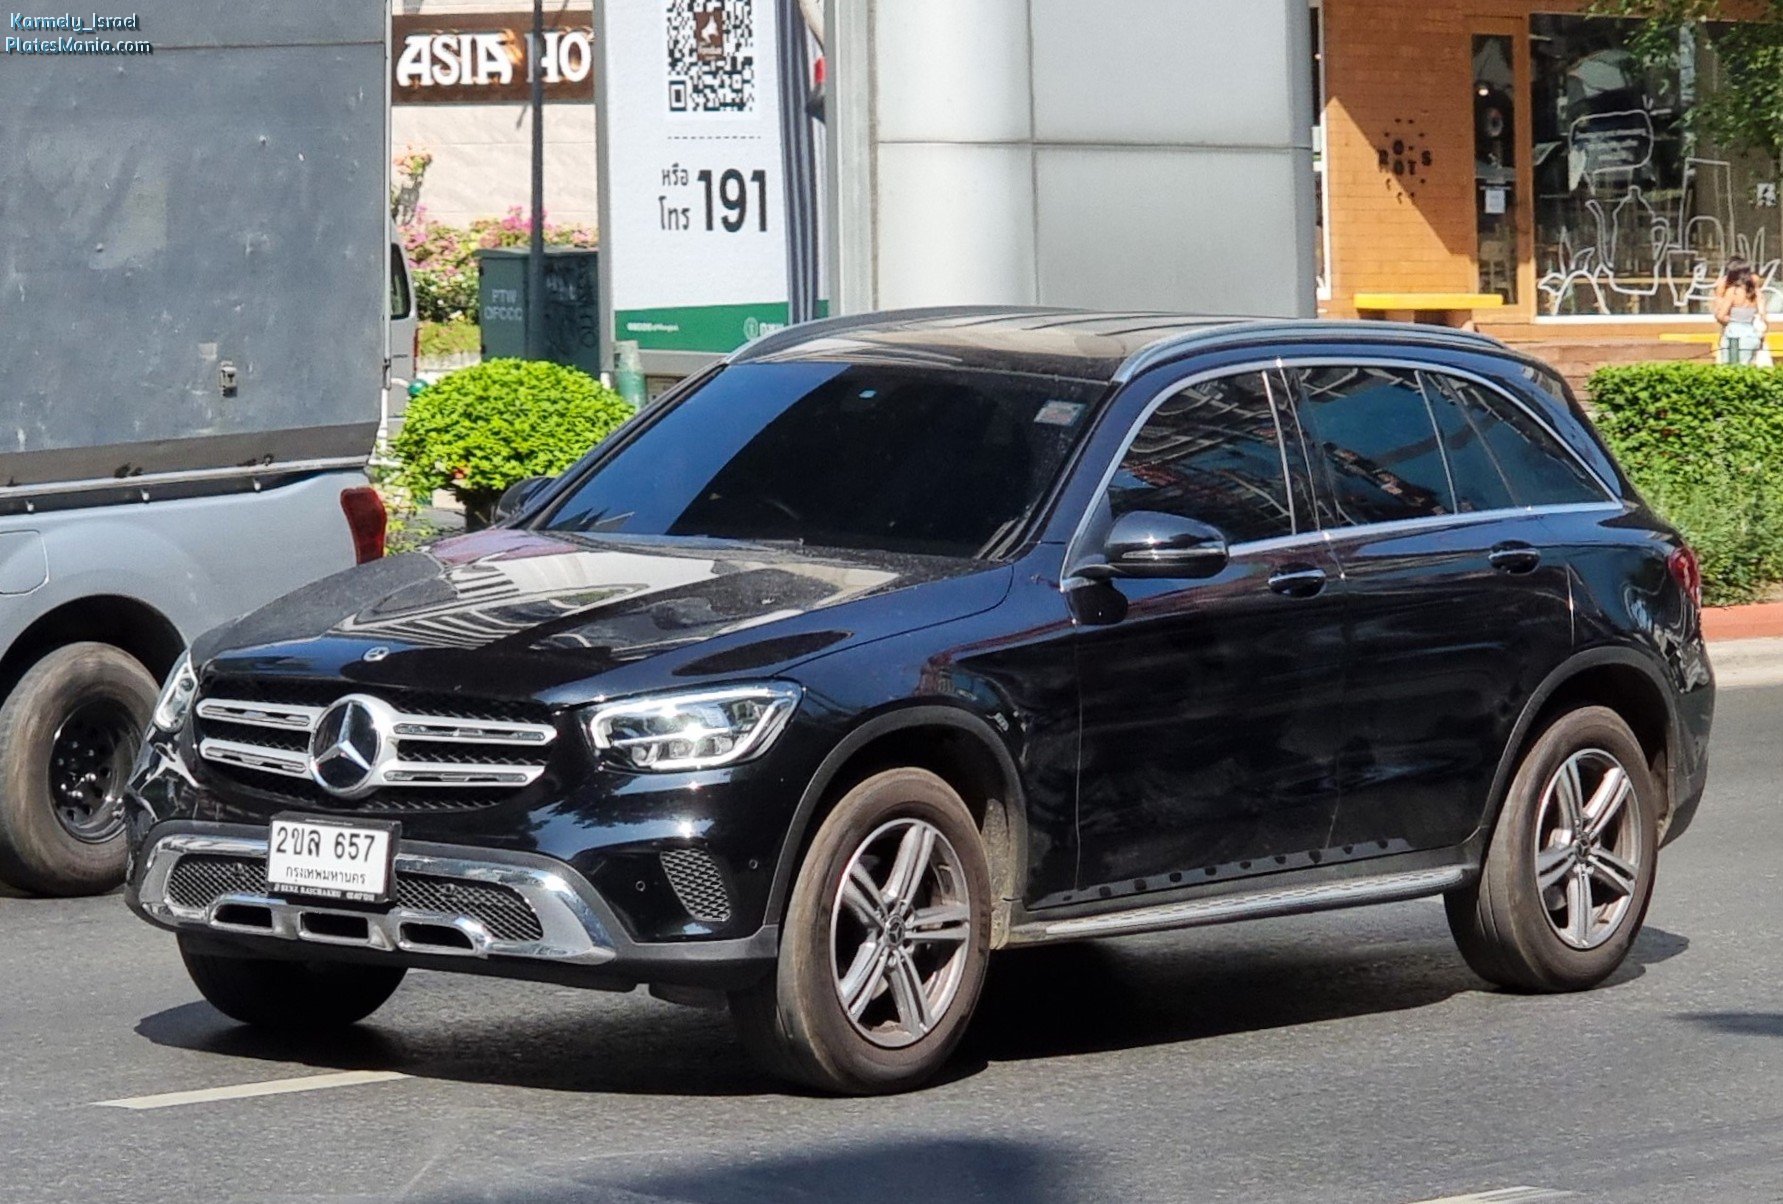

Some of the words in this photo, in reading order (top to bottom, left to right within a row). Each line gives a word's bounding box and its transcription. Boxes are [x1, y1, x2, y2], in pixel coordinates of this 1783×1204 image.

[396, 33, 514, 87] ASIA
[661, 162, 689, 187] หรือ
[658, 195, 691, 231] โทร
[697, 168, 768, 233] 191
[276, 826, 322, 858] 2ขล
[334, 831, 376, 863] 657
[285, 865, 368, 885] กรุงเทพมหานคร
